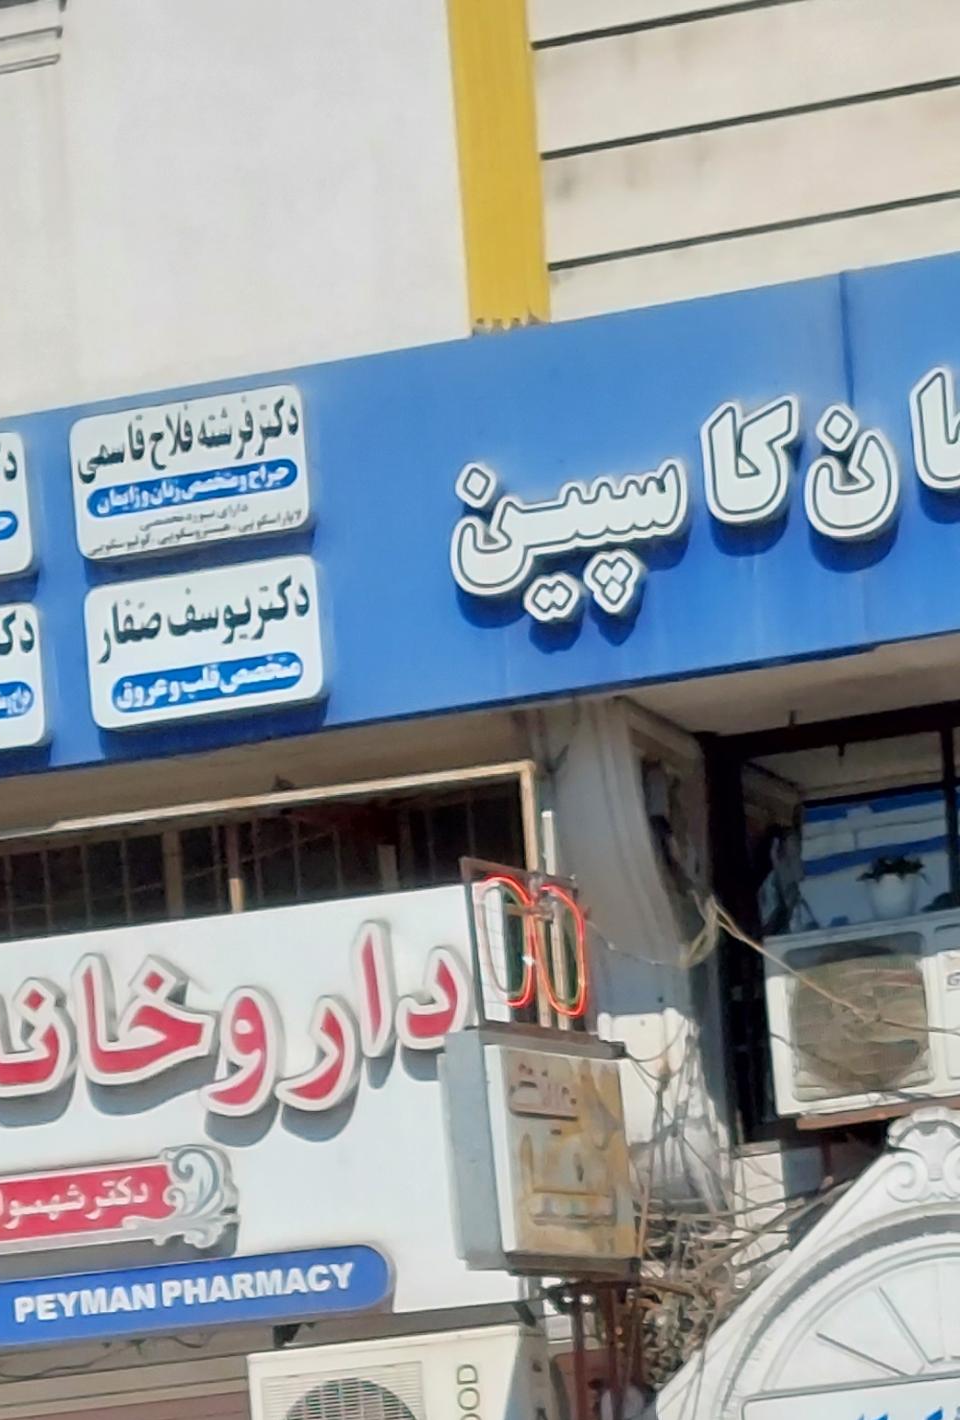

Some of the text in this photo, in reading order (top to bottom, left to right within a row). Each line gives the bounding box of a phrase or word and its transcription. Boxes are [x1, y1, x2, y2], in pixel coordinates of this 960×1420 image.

[77, 394, 300, 484] دکتر فرشته فلاح قاسمی
[150, 479, 182, 505] زنان
[182, 472, 239, 499] متخصص
[249, 464, 290, 490] جراح
[96, 486, 141, 515] زایمان
[450, 393, 799, 622] کاسپین
[167, 587, 251, 645] یوسف
[251, 574, 310, 641] دکتر
[116, 677, 170, 710] عروق
[180, 663, 221, 700] قلب
[218, 655, 302, 694] متخصص
[85, 1175, 149, 1219] دکتر
[13, 1262, 354, 1323] PEYMAN PHARMACY
